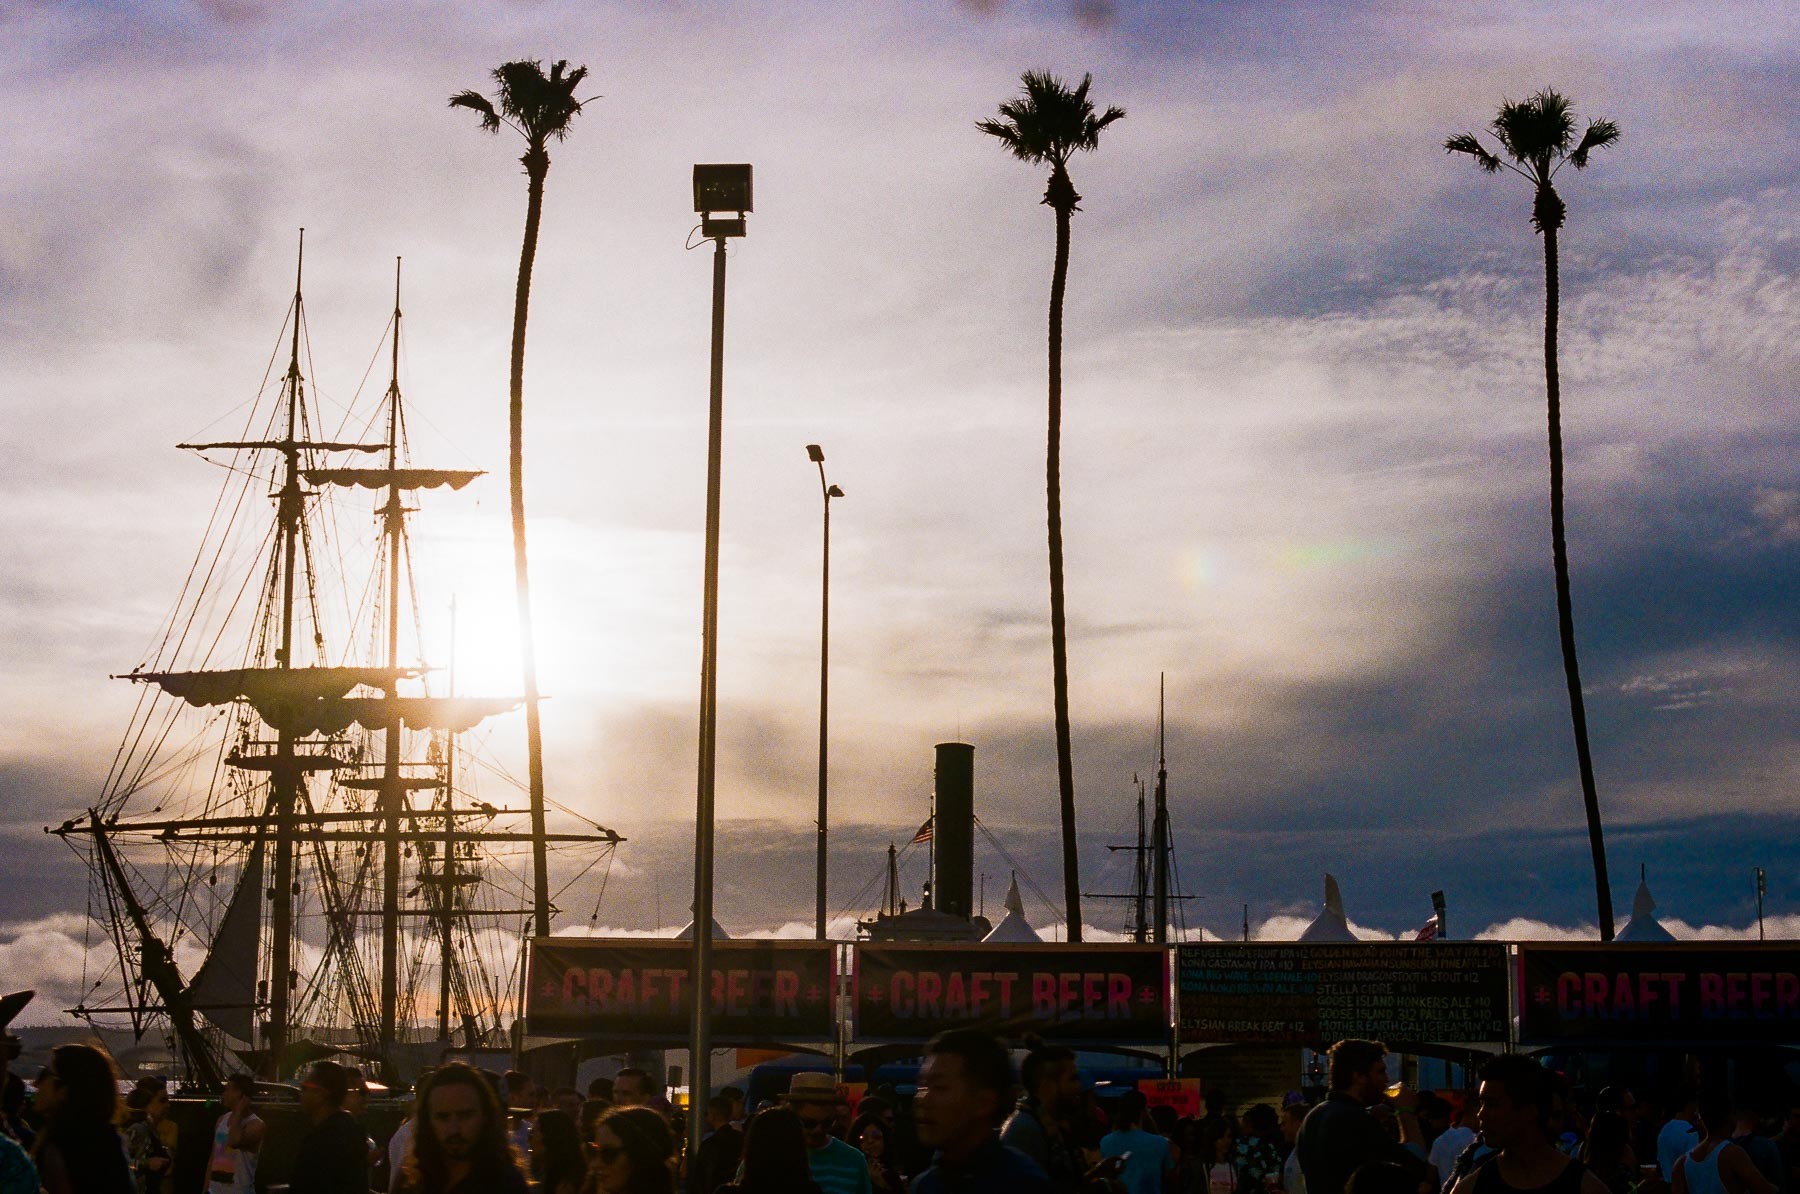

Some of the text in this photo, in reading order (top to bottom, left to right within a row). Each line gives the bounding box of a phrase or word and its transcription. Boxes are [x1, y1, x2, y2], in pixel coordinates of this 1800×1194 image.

[1181, 948, 1222, 958] REFUGE
[1411, 947, 1432, 958] THE
[1436, 947, 1463, 958] WAY
[1181, 959, 1206, 970] KONA
[1207, 959, 1258, 970] CASTAWAY
[1260, 959, 1276, 970] IPA
[1430, 971, 1461, 983] STOUT
[562, 967, 801, 1017] CRAFT BEER
[889, 970, 1134, 1020] CRAFT BEER
[1316, 983, 1359, 995] STELLA
[1361, 983, 1393, 995] CIDRE
[1554, 970, 1800, 1021] CRAFT BEER
[1316, 996, 1353, 1008] GOOSE
[1356, 996, 1395, 1008] ISLAND
[1397, 996, 1448, 1008] HONKERS
[1451, 996, 1472, 1008] ALE
[1317, 1008, 1354, 1020] GOOSE
[1356, 1008, 1393, 1020] ISLAND
[1397, 1008, 1416, 1020] 312
[1420, 1008, 1444, 1020] PALE
[1448, 1008, 1471, 1020] ALE
[1181, 1019, 1225, 1032] ELYSIAN
[1227, 1019, 1261, 1032] BREAK
[1262, 1019, 1286, 1032] BEAT
[1318, 1020, 1365, 1032] MOTHER
[1366, 1020, 1399, 1032] EARTH
[1400, 1020, 1427, 1032] CALI
[1377, 1031, 1444, 1042] APOCALYPSE
[1450, 1031, 1466, 1042] IPA
